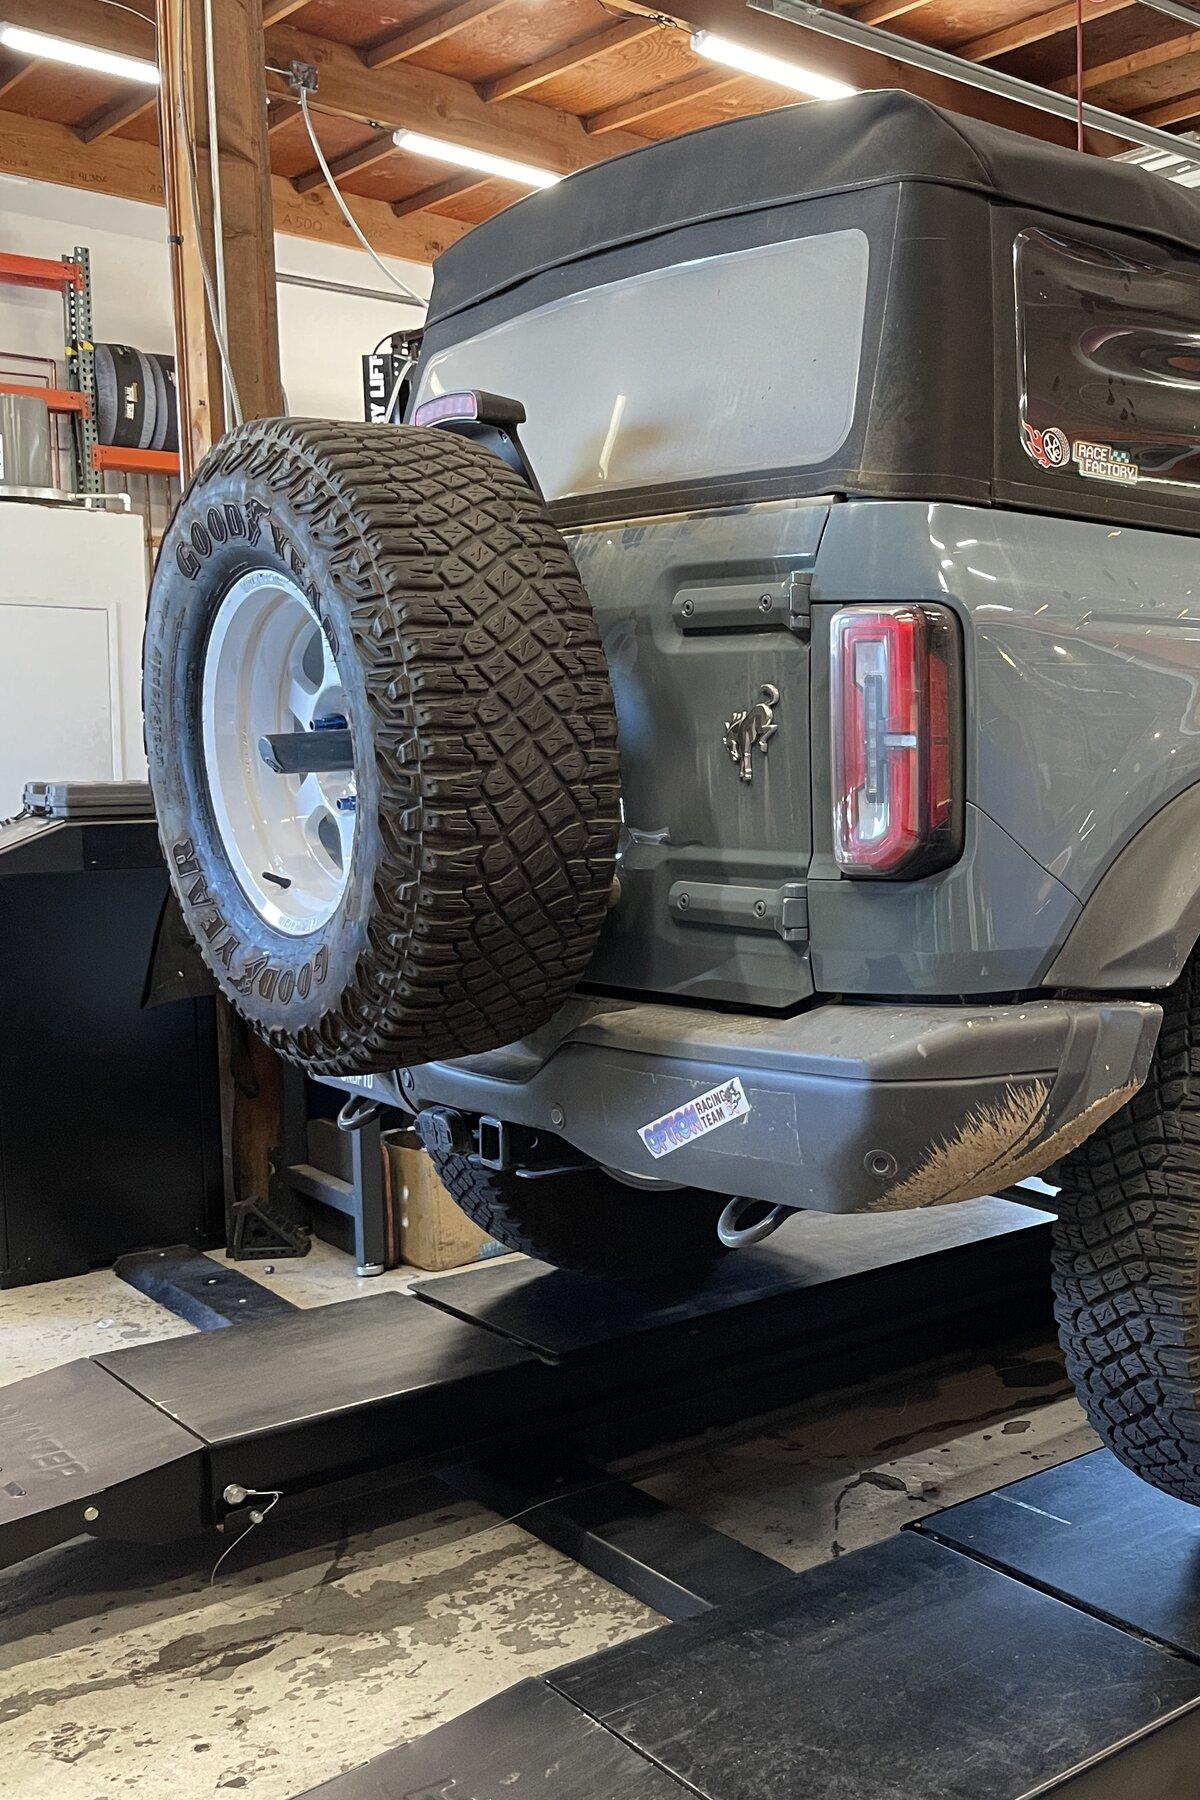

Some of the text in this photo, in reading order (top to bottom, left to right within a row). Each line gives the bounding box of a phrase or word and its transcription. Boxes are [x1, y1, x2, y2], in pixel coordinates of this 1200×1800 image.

[369, 355, 385, 398] LIFT
[1079, 444, 1108, 462] RACE
[1085, 458, 1136, 480] FACTORY
[695, 1090, 727, 1115] RACING
[700, 1106, 726, 1128] TEAM
